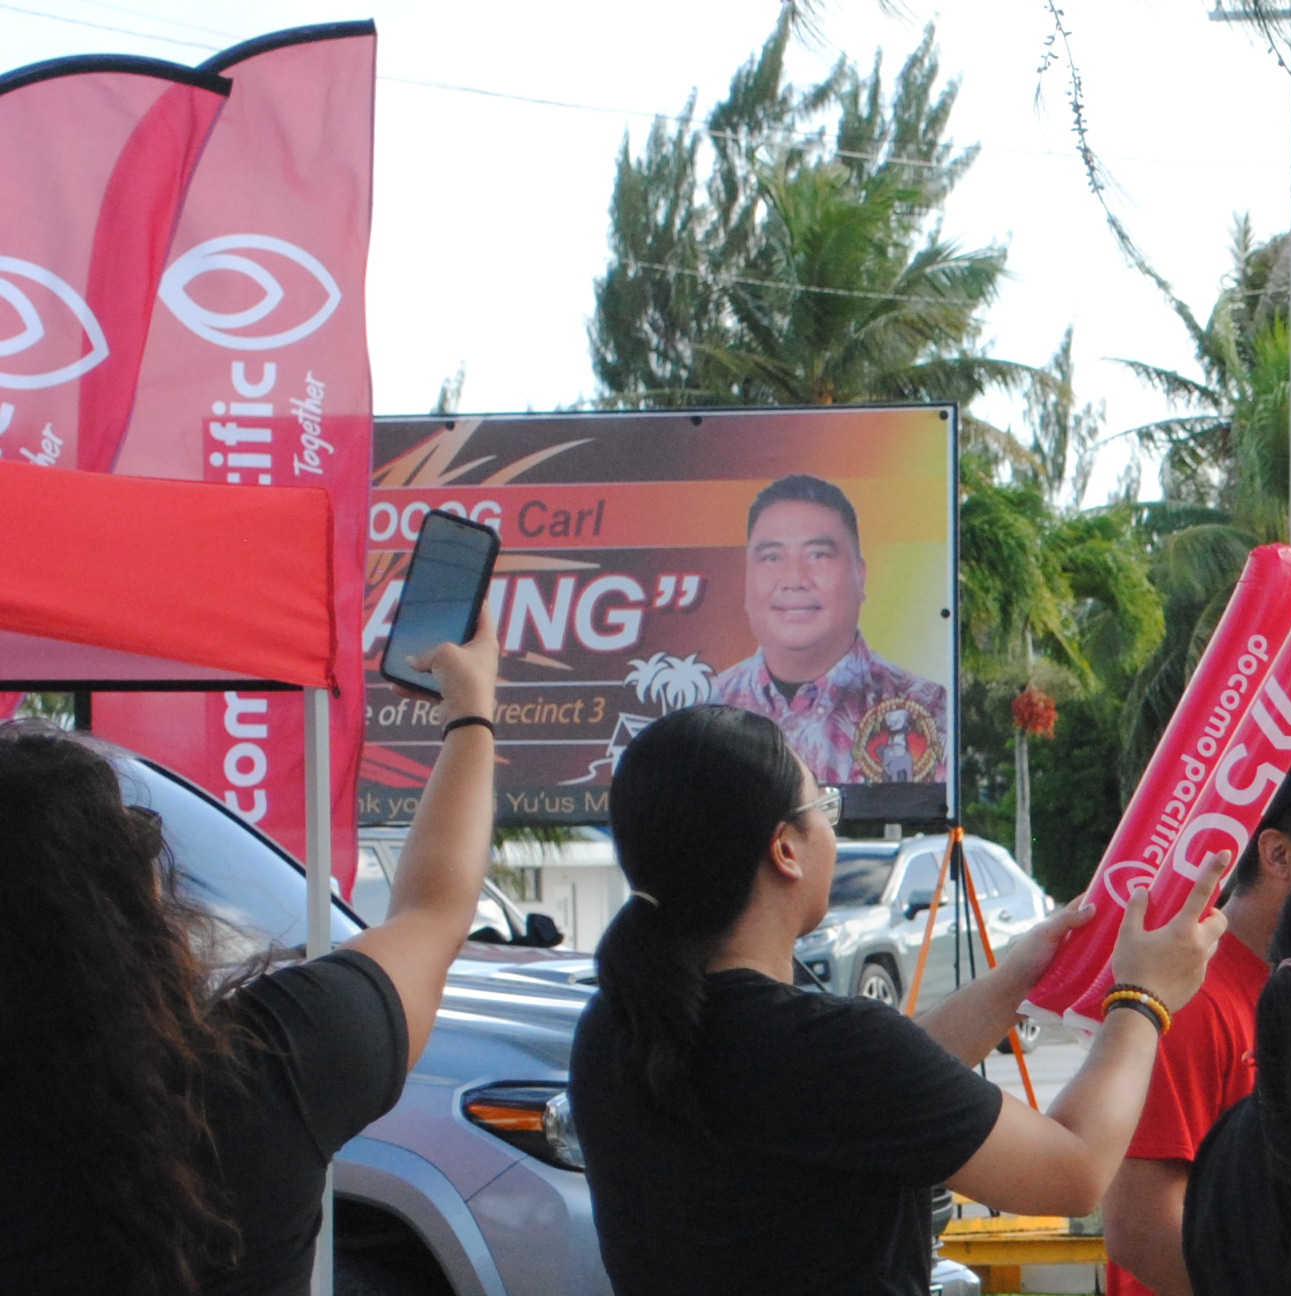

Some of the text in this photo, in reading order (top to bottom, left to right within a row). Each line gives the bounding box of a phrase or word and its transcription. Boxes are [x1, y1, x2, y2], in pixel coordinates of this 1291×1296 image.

[290, 371, 333, 478] Together
[517, 499, 605, 538] Carl
[378, 698, 409, 726] of
[493, 699, 583, 725] recinct
[592, 697, 606, 723] 3
[1143, 634, 1269, 865] docomo pacific
[1172, 742, 1286, 890] 5G
